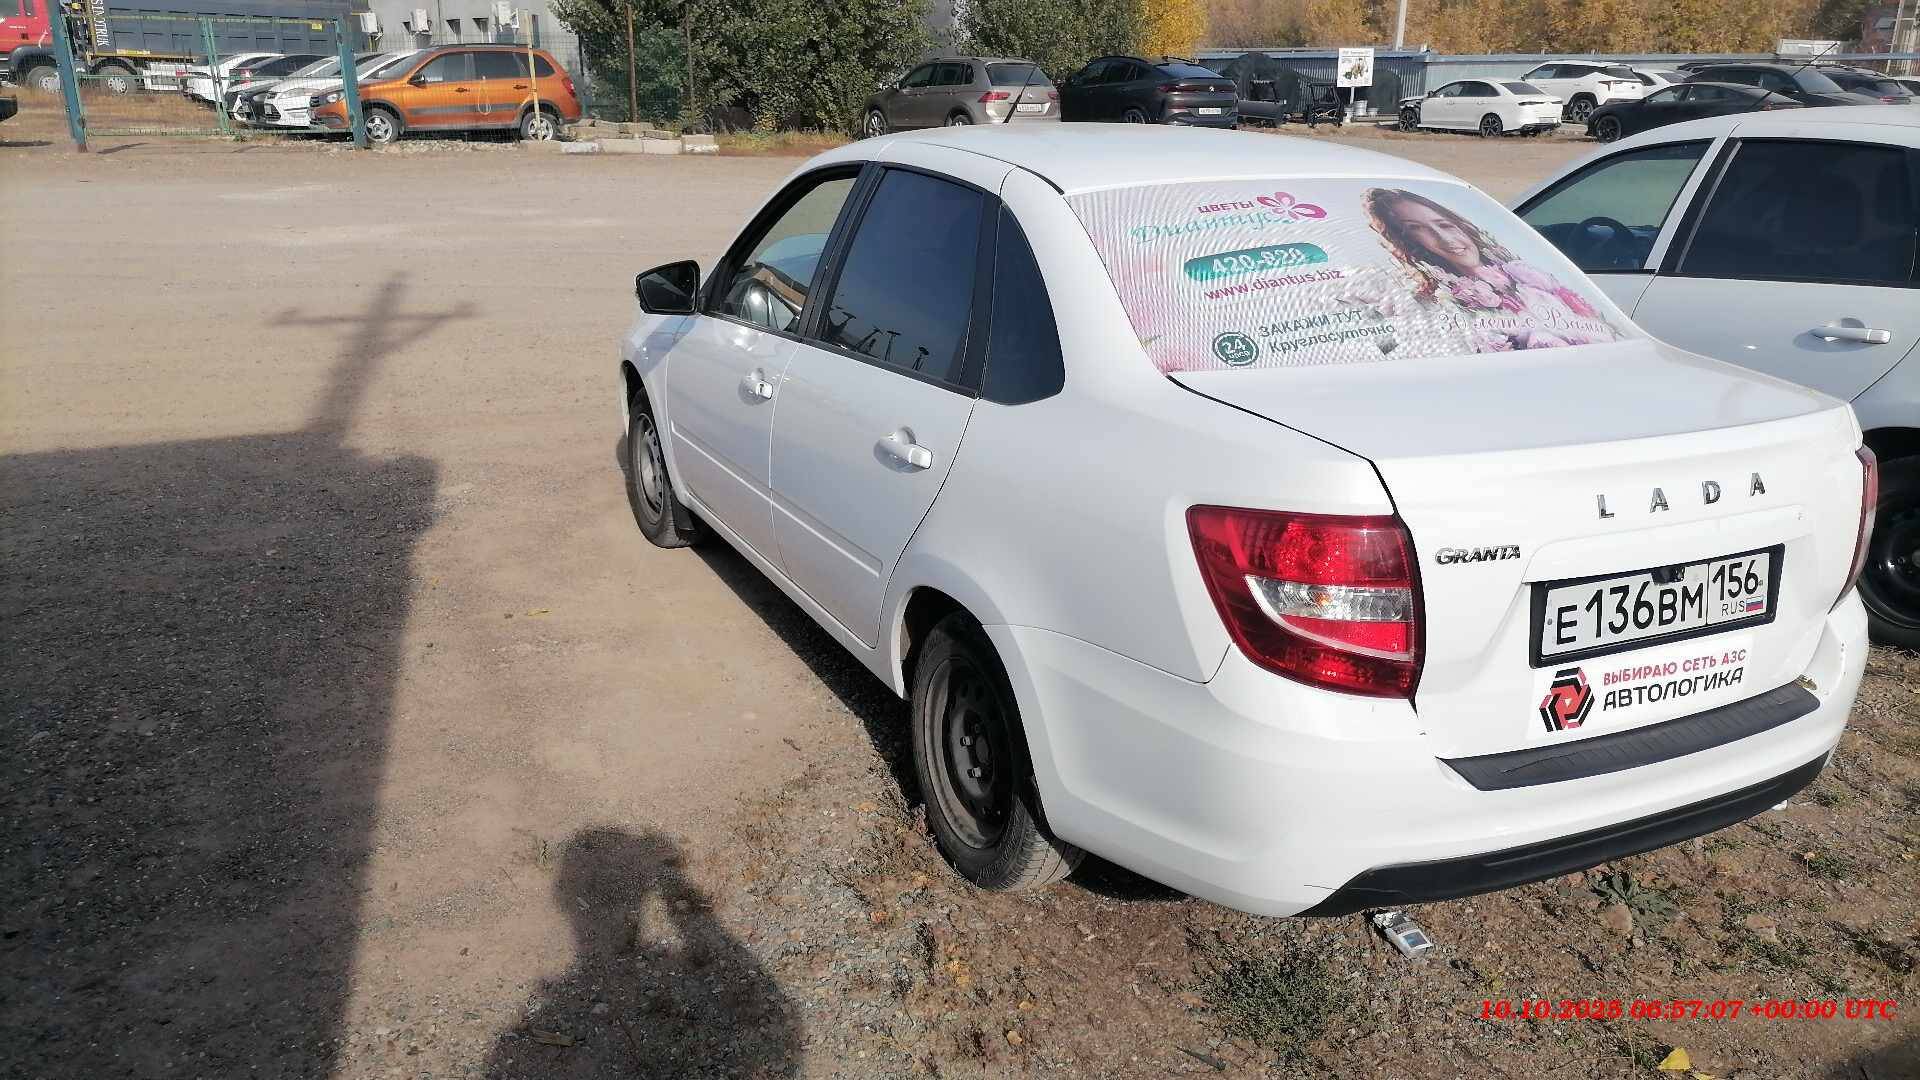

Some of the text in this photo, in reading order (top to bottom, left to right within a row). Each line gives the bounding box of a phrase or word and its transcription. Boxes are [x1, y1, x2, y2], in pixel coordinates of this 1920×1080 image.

[1197, 200, 1254, 214] ЦВЕТЫ
[1212, 247, 1306, 273] 420-820
[1204, 267, 1345, 300] www.diantus.biz
[1258, 310, 1363, 338] ЗАКАЖИ ТУТ
[1221, 338, 1246, 355] 24
[1269, 324, 1395, 354] Круглосуточно
[1596, 472, 1766, 519] LADA
[1434, 544, 1521, 565] GRANTA
[1711, 559, 1760, 602] 156
[1720, 600, 1745, 617] RUS
[1603, 649, 1747, 686] ВЫБИРАЮ СЕТЬ АЗС
[1603, 667, 1744, 712] АВТОЛОГИКА
